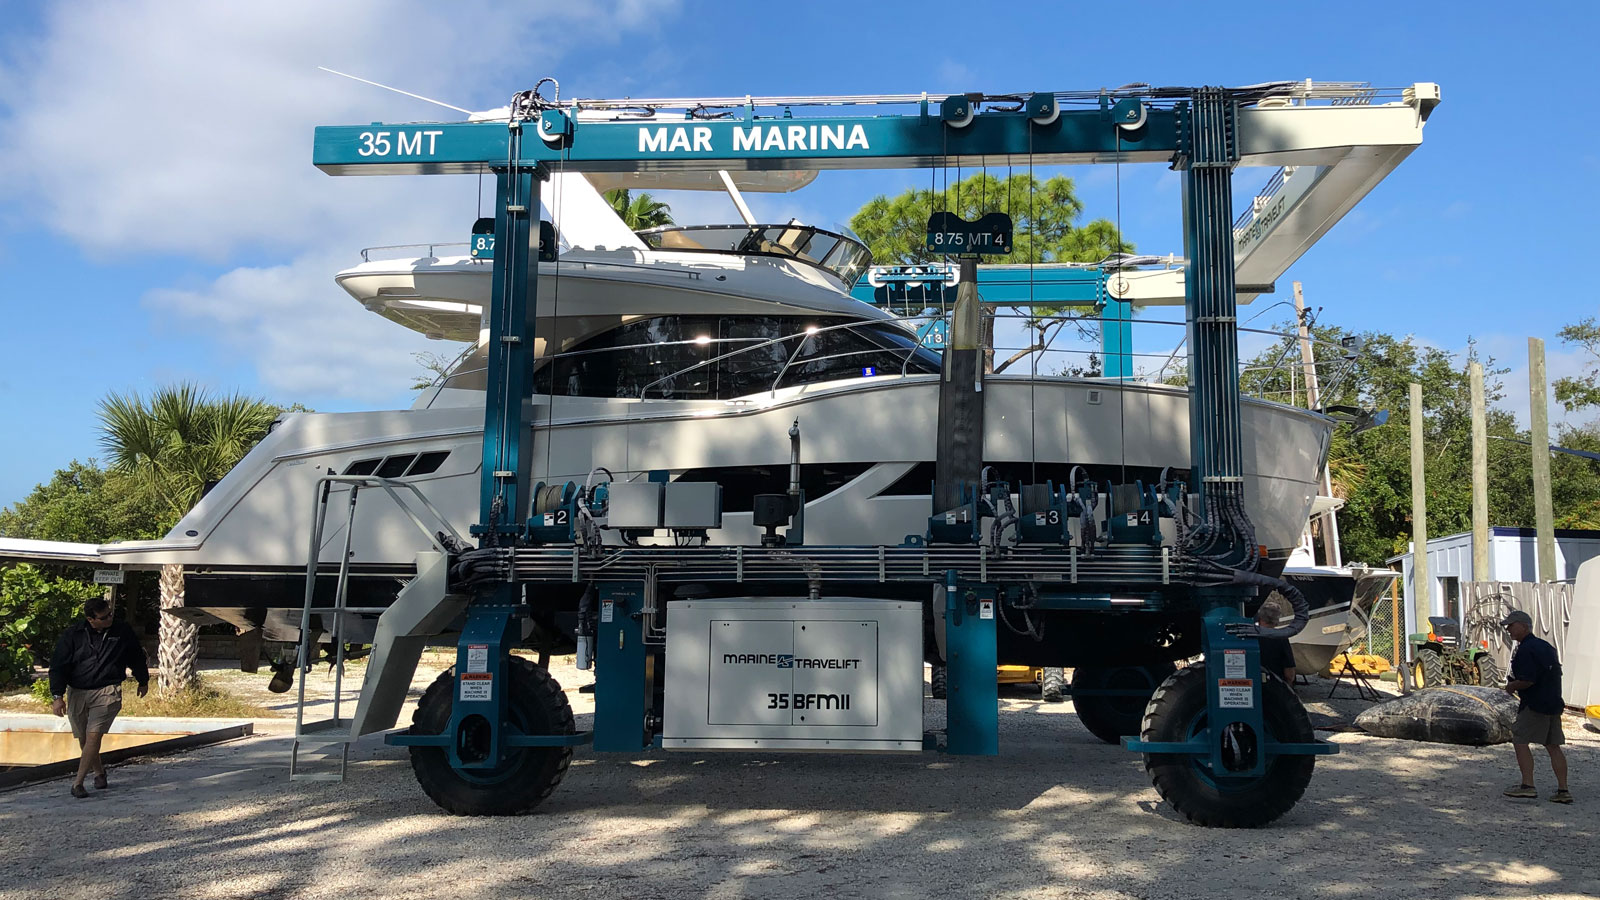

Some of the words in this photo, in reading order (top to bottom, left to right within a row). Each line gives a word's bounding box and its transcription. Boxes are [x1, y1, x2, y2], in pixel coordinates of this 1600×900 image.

[358, 131, 391, 156] 35
[397, 130, 443, 156] MT
[638, 126, 714, 152] MAR
[732, 124, 870, 151] MARINA
[476, 237, 495, 251] 8.7
[968, 232, 992, 245] MT
[994, 233, 1004, 246] 4
[935, 334, 943, 344] 3
[557, 510, 567, 524] 2
[961, 510, 968, 523] 1
[1049, 510, 1059, 524] 3
[1140, 510, 1151, 524] 4
[723, 654, 776, 664] MARINE
[795, 659, 860, 669] TRAVELIFT
[768, 694, 789, 709] 35
[793, 694, 850, 710] BFMII
